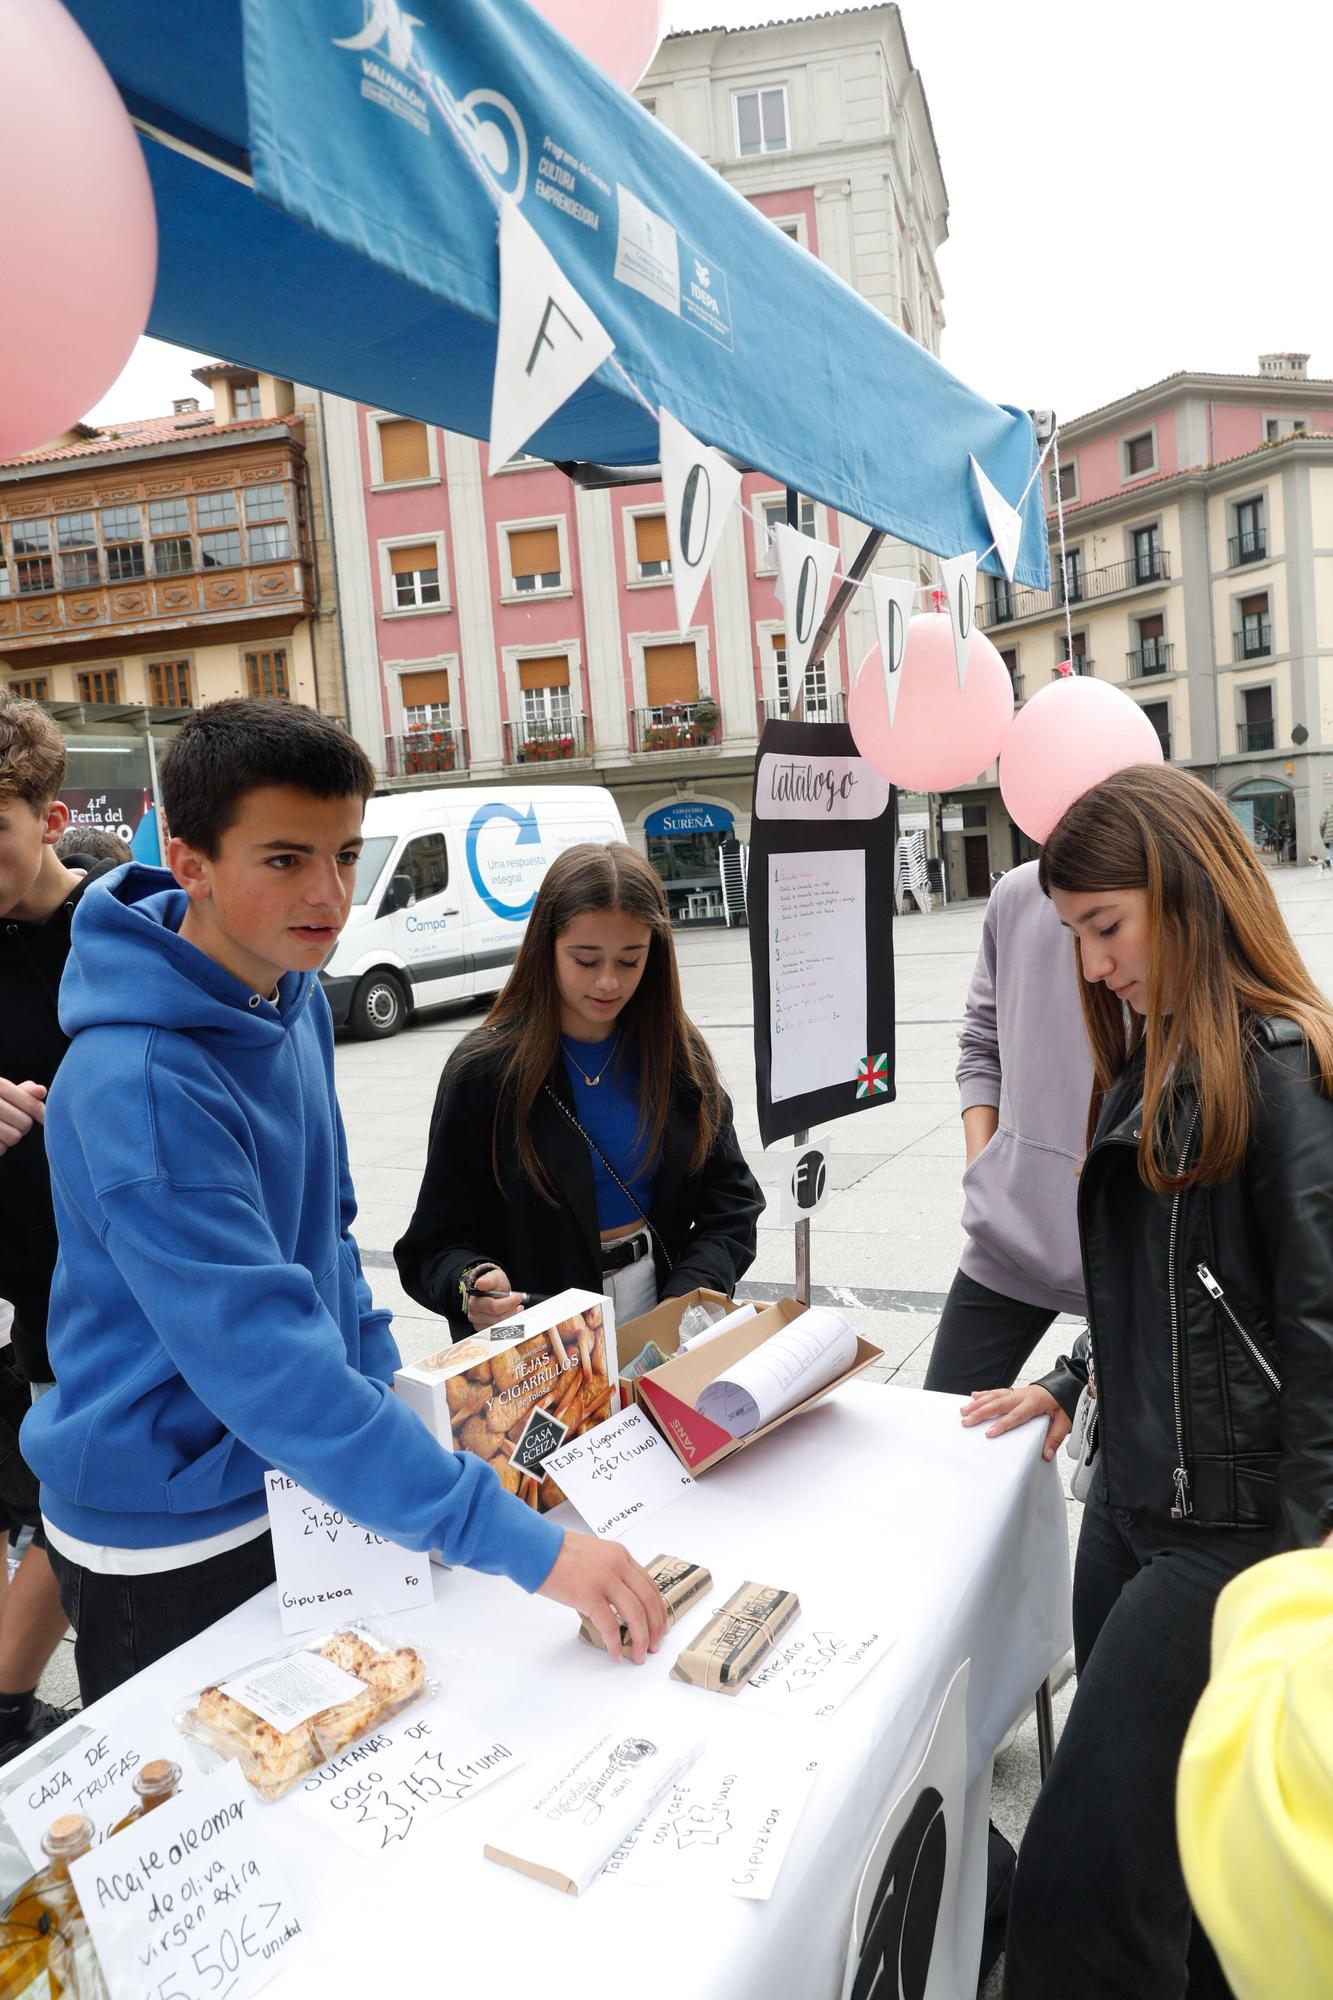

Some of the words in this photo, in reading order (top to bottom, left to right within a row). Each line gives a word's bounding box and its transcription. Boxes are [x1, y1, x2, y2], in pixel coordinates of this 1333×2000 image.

[538, 156, 576, 193] CULTURA
[535, 178, 599, 232] EMPRENDEDORA
[691, 281, 720, 316] IDEPA
[70, 809, 103, 823] Feria
[105, 808, 123, 822] del
[663, 814, 715, 830] SUREÑA
[487, 859, 505, 871] Una
[506, 855, 547, 873] respuesta
[405, 916, 446, 933] Campa
[486, 1398, 494, 1411] Y
[498, 1353, 579, 1405] CIGARRILLOS
[512, 1352, 550, 1379] TEJAS
[523, 1438, 557, 1464] ECEIZA
[525, 1427, 552, 1449] CASA
[669, 1419, 697, 1458] VANS
[546, 1448, 583, 1472] TEJAS
[282, 1588, 353, 1608] Gipuzkoa
[28, 1770, 73, 1810] CAJA
[85, 1735, 111, 1767] DE
[304, 1734, 393, 1792] SULTANAS
[404, 1720, 432, 1740] DE
[73, 1750, 141, 1808] TRUFAS
[330, 1772, 383, 1810] COCO
[653, 1822, 671, 1844] CON
[96, 1853, 164, 1908] Aceite
[148, 1894, 174, 1923] de
[180, 1860, 226, 1903] oliva
[214, 1860, 262, 1905] extra
